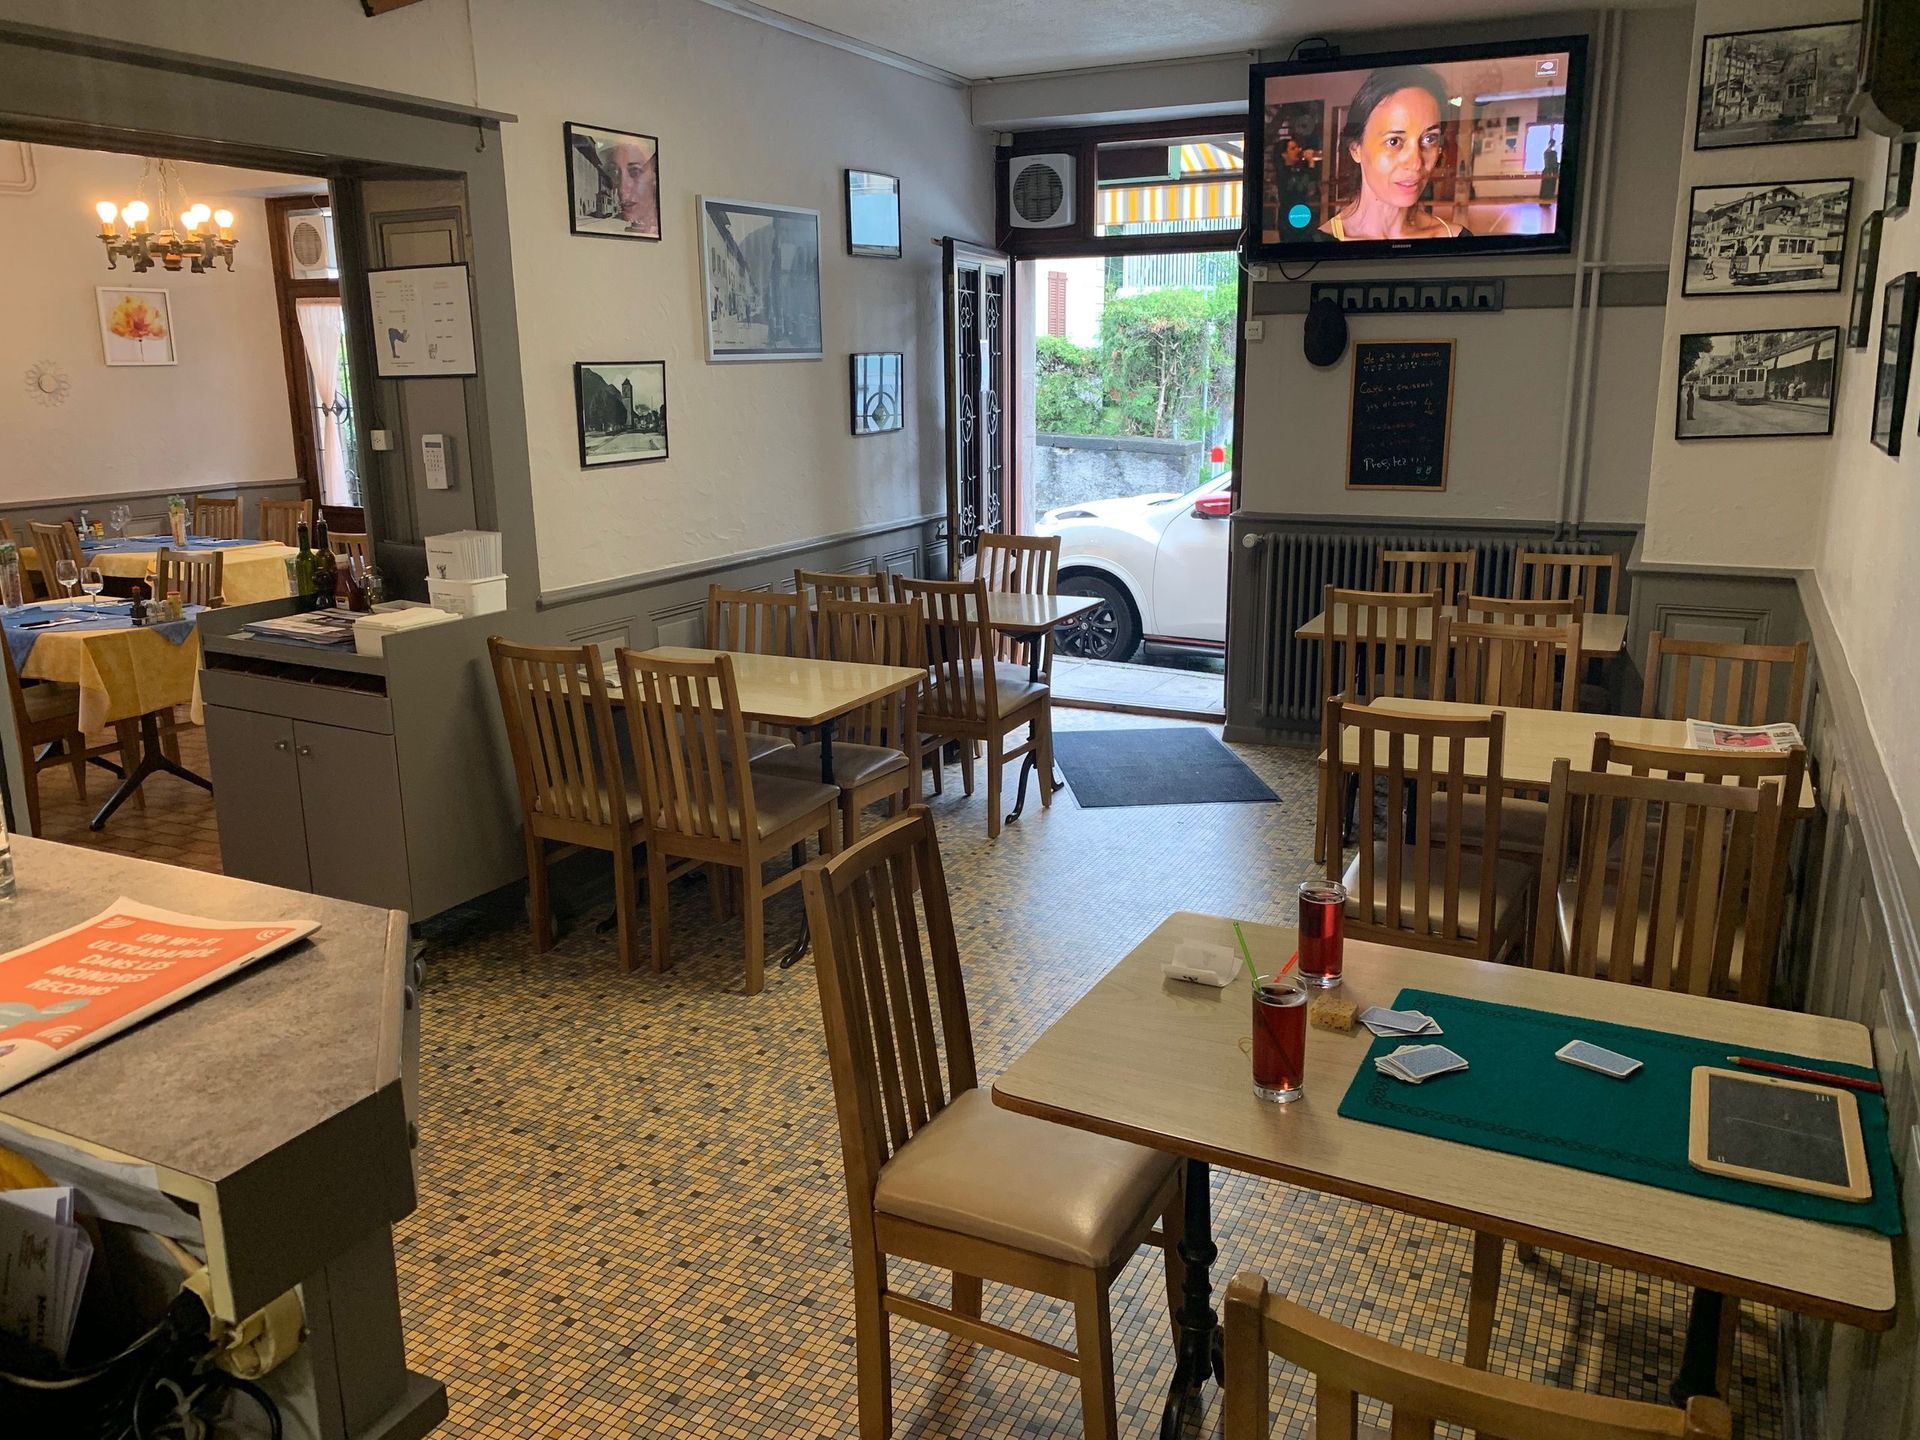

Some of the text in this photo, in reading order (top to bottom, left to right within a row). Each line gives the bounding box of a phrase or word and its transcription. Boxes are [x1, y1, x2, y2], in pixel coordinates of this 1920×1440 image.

[136, 933, 169, 945] UN
[87, 939, 222, 959] ULTRARAPIDE
[79, 954, 177, 971] DANS LES
[44, 965, 156, 983] MOINDRES
[25, 978, 119, 996] RECOINS
